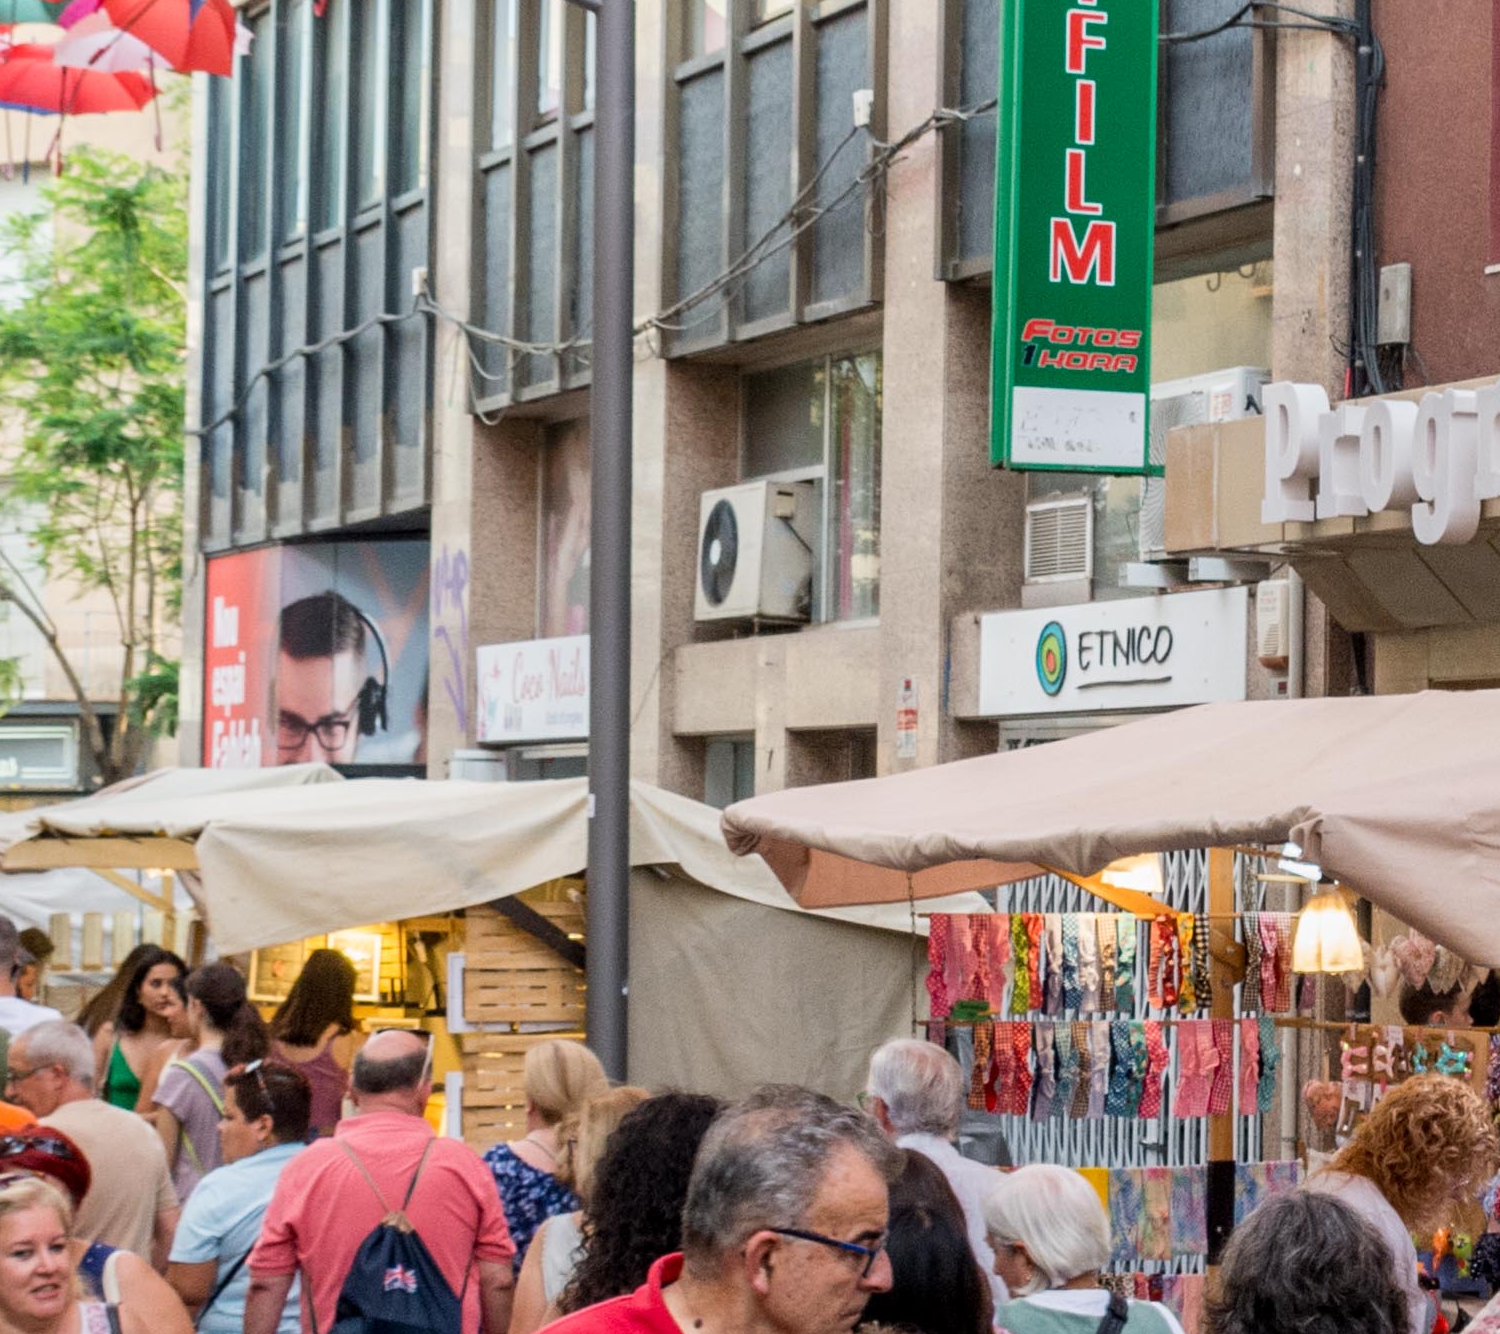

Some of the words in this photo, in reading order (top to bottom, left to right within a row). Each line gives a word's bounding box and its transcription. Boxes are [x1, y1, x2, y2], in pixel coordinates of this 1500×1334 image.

[1024, 345, 1037, 366] 1
[1037, 350, 1138, 374] HORA
[212, 595, 240, 649] Nou
[1077, 624, 1174, 671] ETNICO
[211, 650, 247, 718] espai
